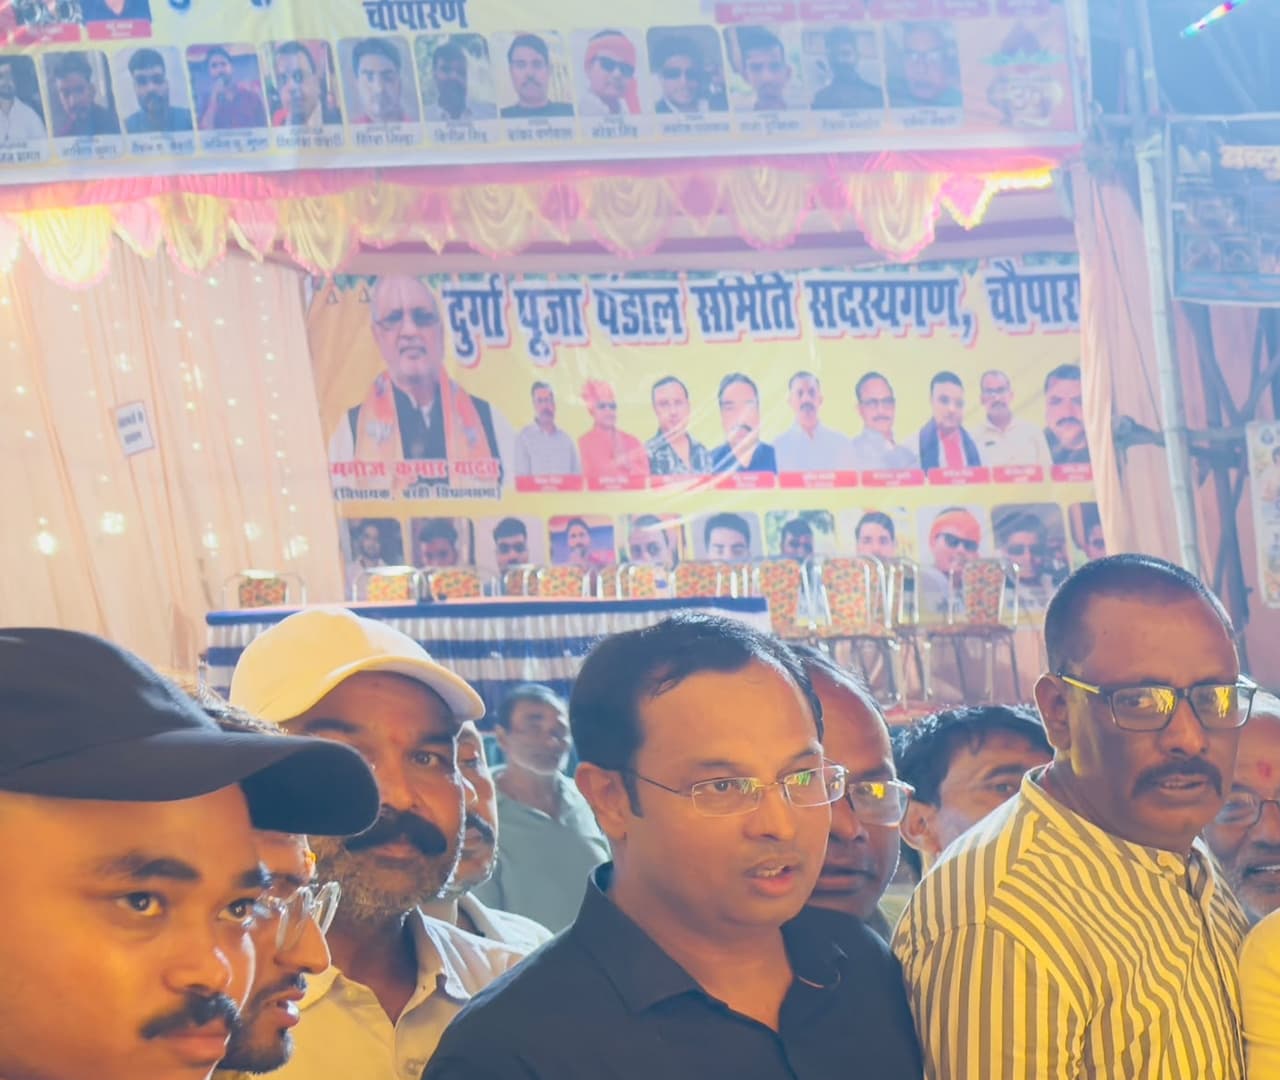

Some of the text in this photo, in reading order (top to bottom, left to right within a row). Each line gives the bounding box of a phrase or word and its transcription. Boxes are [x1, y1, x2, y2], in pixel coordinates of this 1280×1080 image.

[442, 272, 504, 358] दुर्गा
[513, 286, 584, 358] पूजा
[592, 272, 684, 336] पंडाल
[690, 274, 794, 333] समिति
[984, 258, 1081, 325] चौपार
